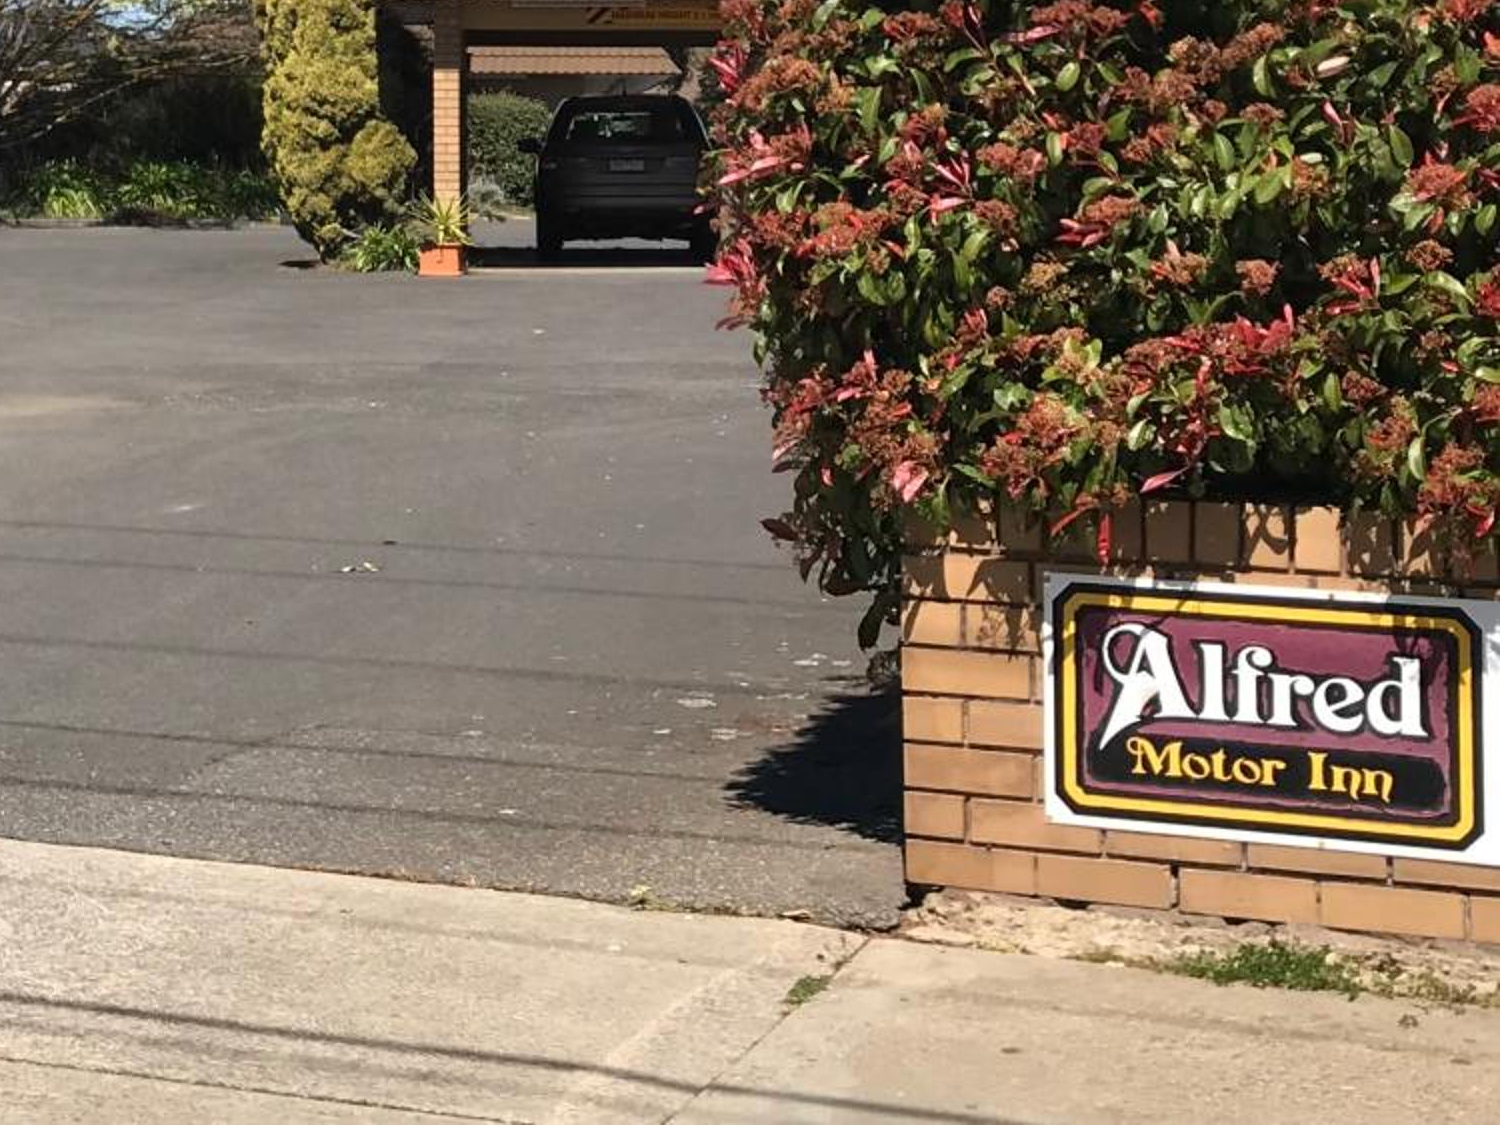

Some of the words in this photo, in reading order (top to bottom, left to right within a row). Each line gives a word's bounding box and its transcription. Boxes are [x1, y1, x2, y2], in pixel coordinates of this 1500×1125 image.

[1100, 622, 1430, 751] Alfred
[1127, 736, 1286, 787] Motor
[1307, 751, 1394, 802] Inn
